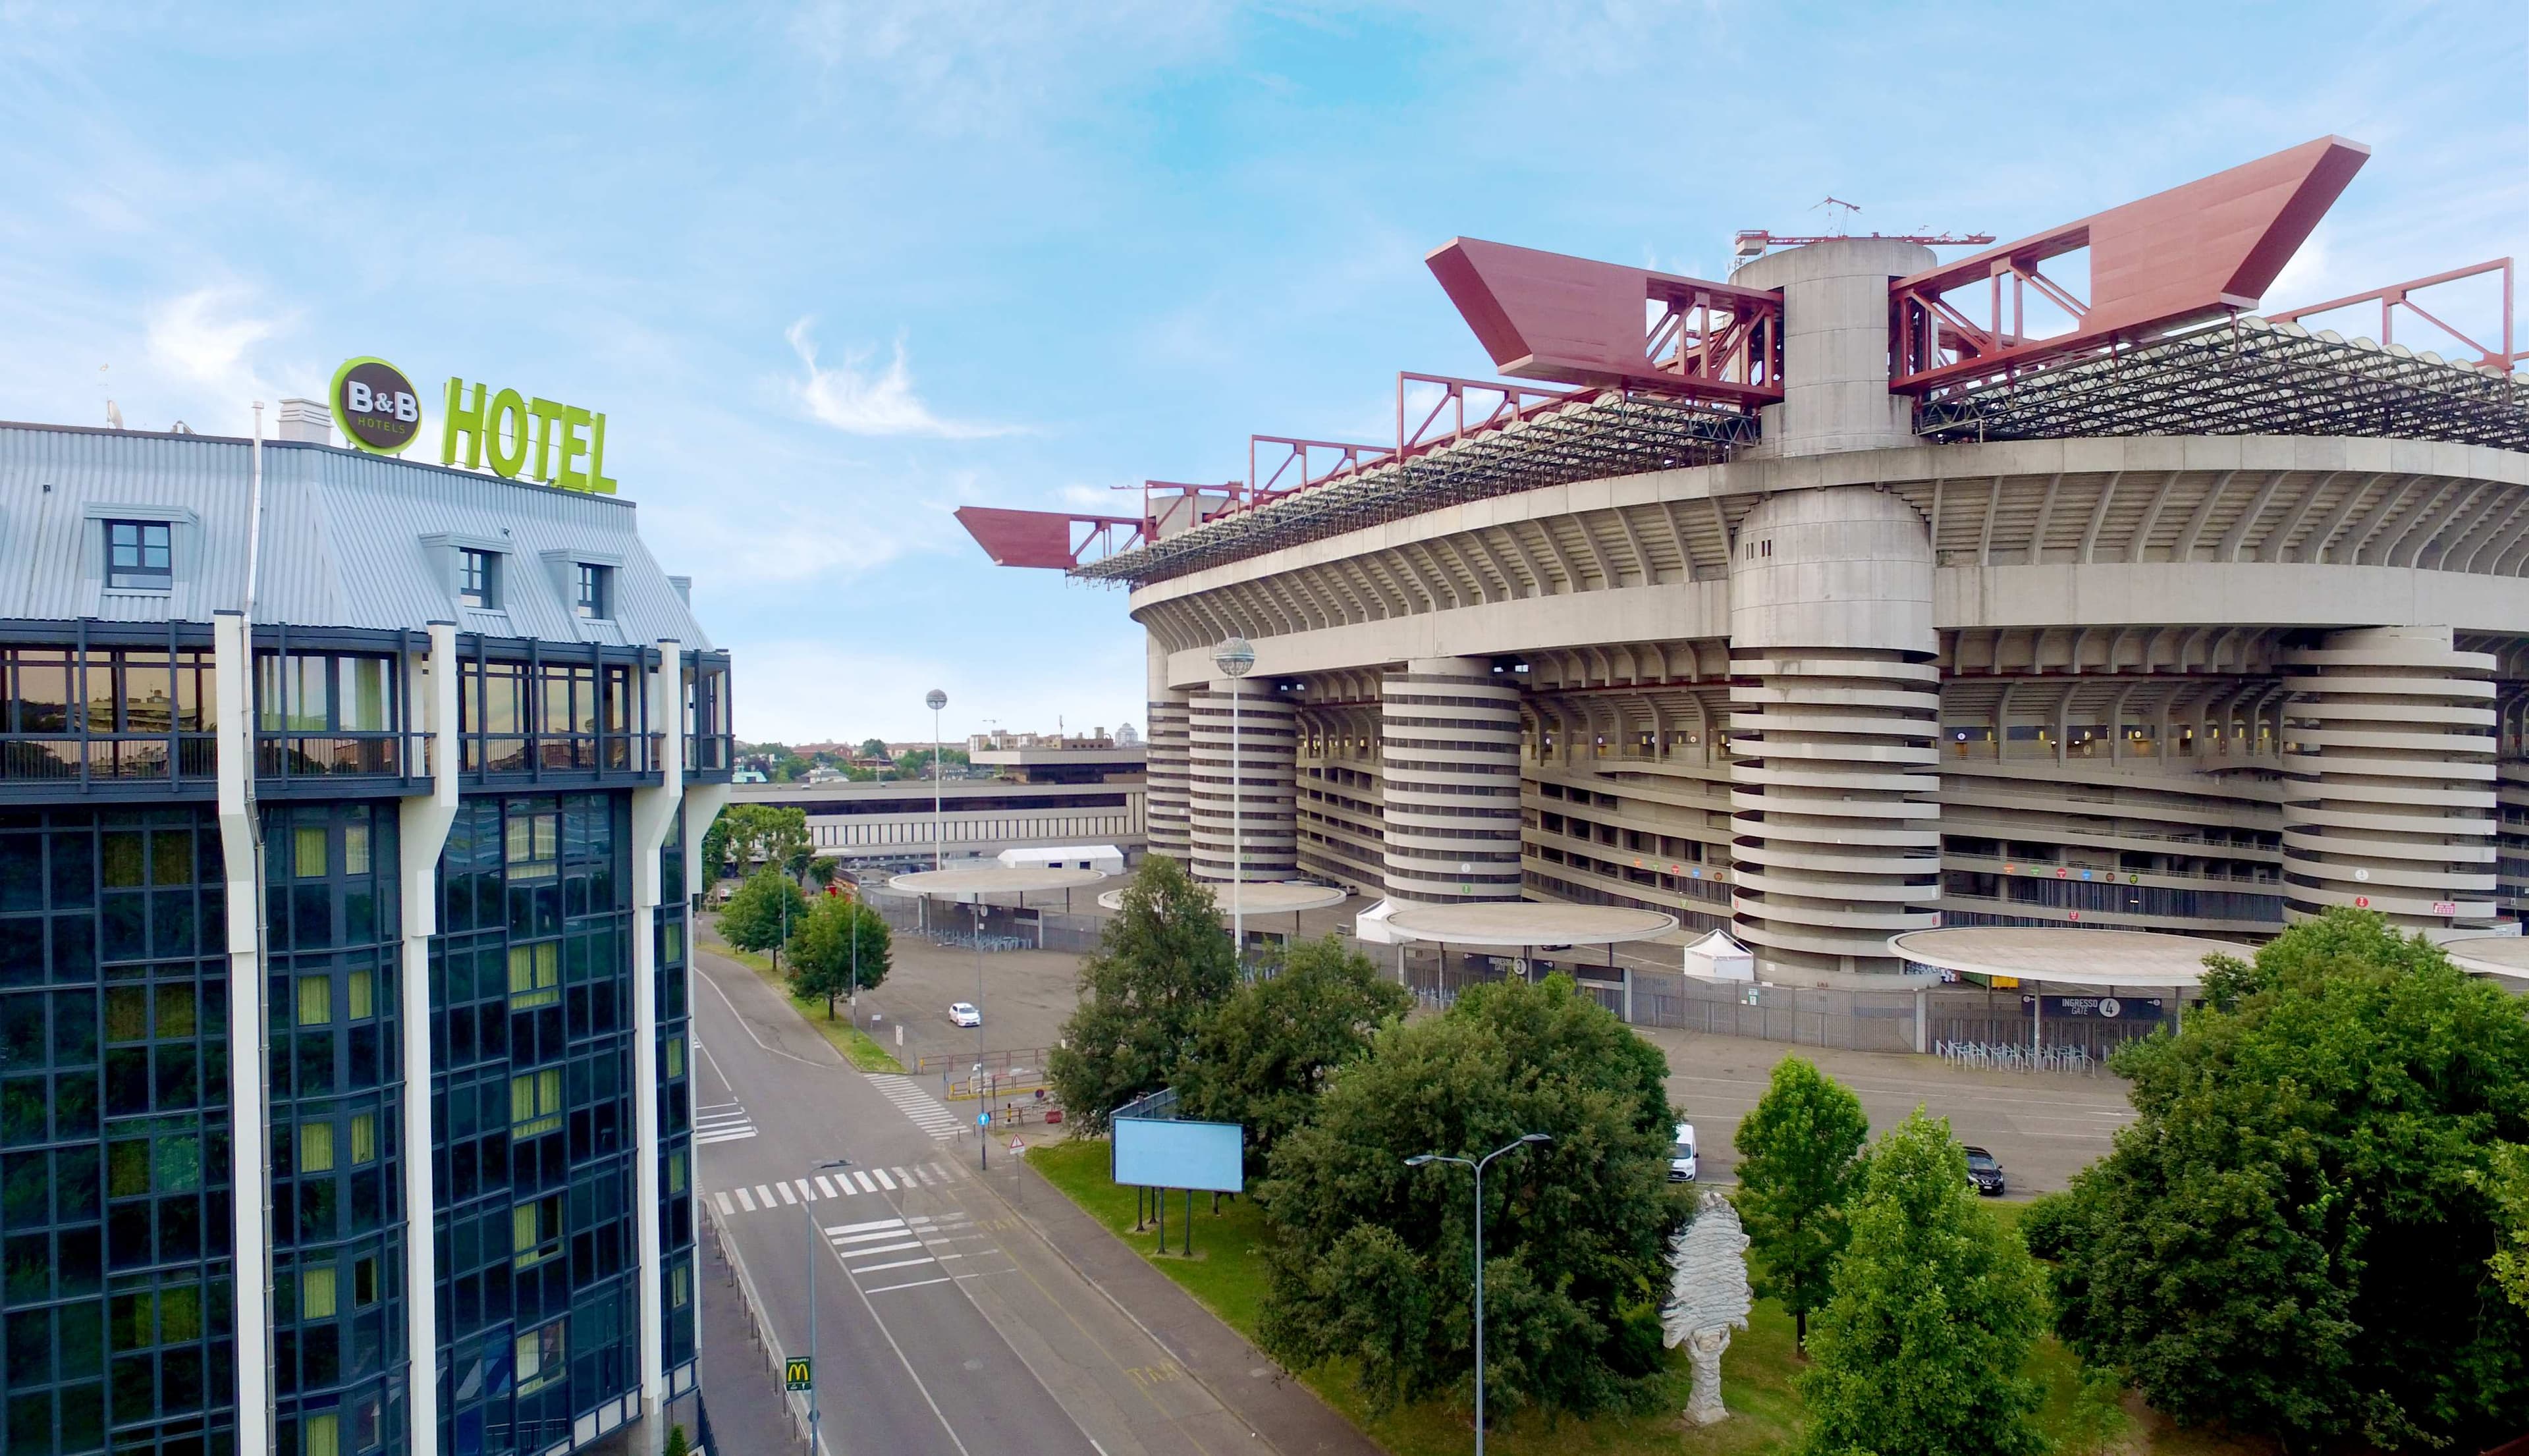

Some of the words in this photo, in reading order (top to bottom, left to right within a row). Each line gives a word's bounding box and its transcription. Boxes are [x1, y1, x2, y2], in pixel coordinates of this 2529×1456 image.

[348, 381, 418, 422] B&B
[358, 416, 406, 434] HOTELS
[441, 377, 617, 495] HOTEL
[2062, 998, 2098, 1008] INGRESSO
[2071, 1007, 2088, 1015] GATE
[2106, 1000, 2113, 1015] 4
